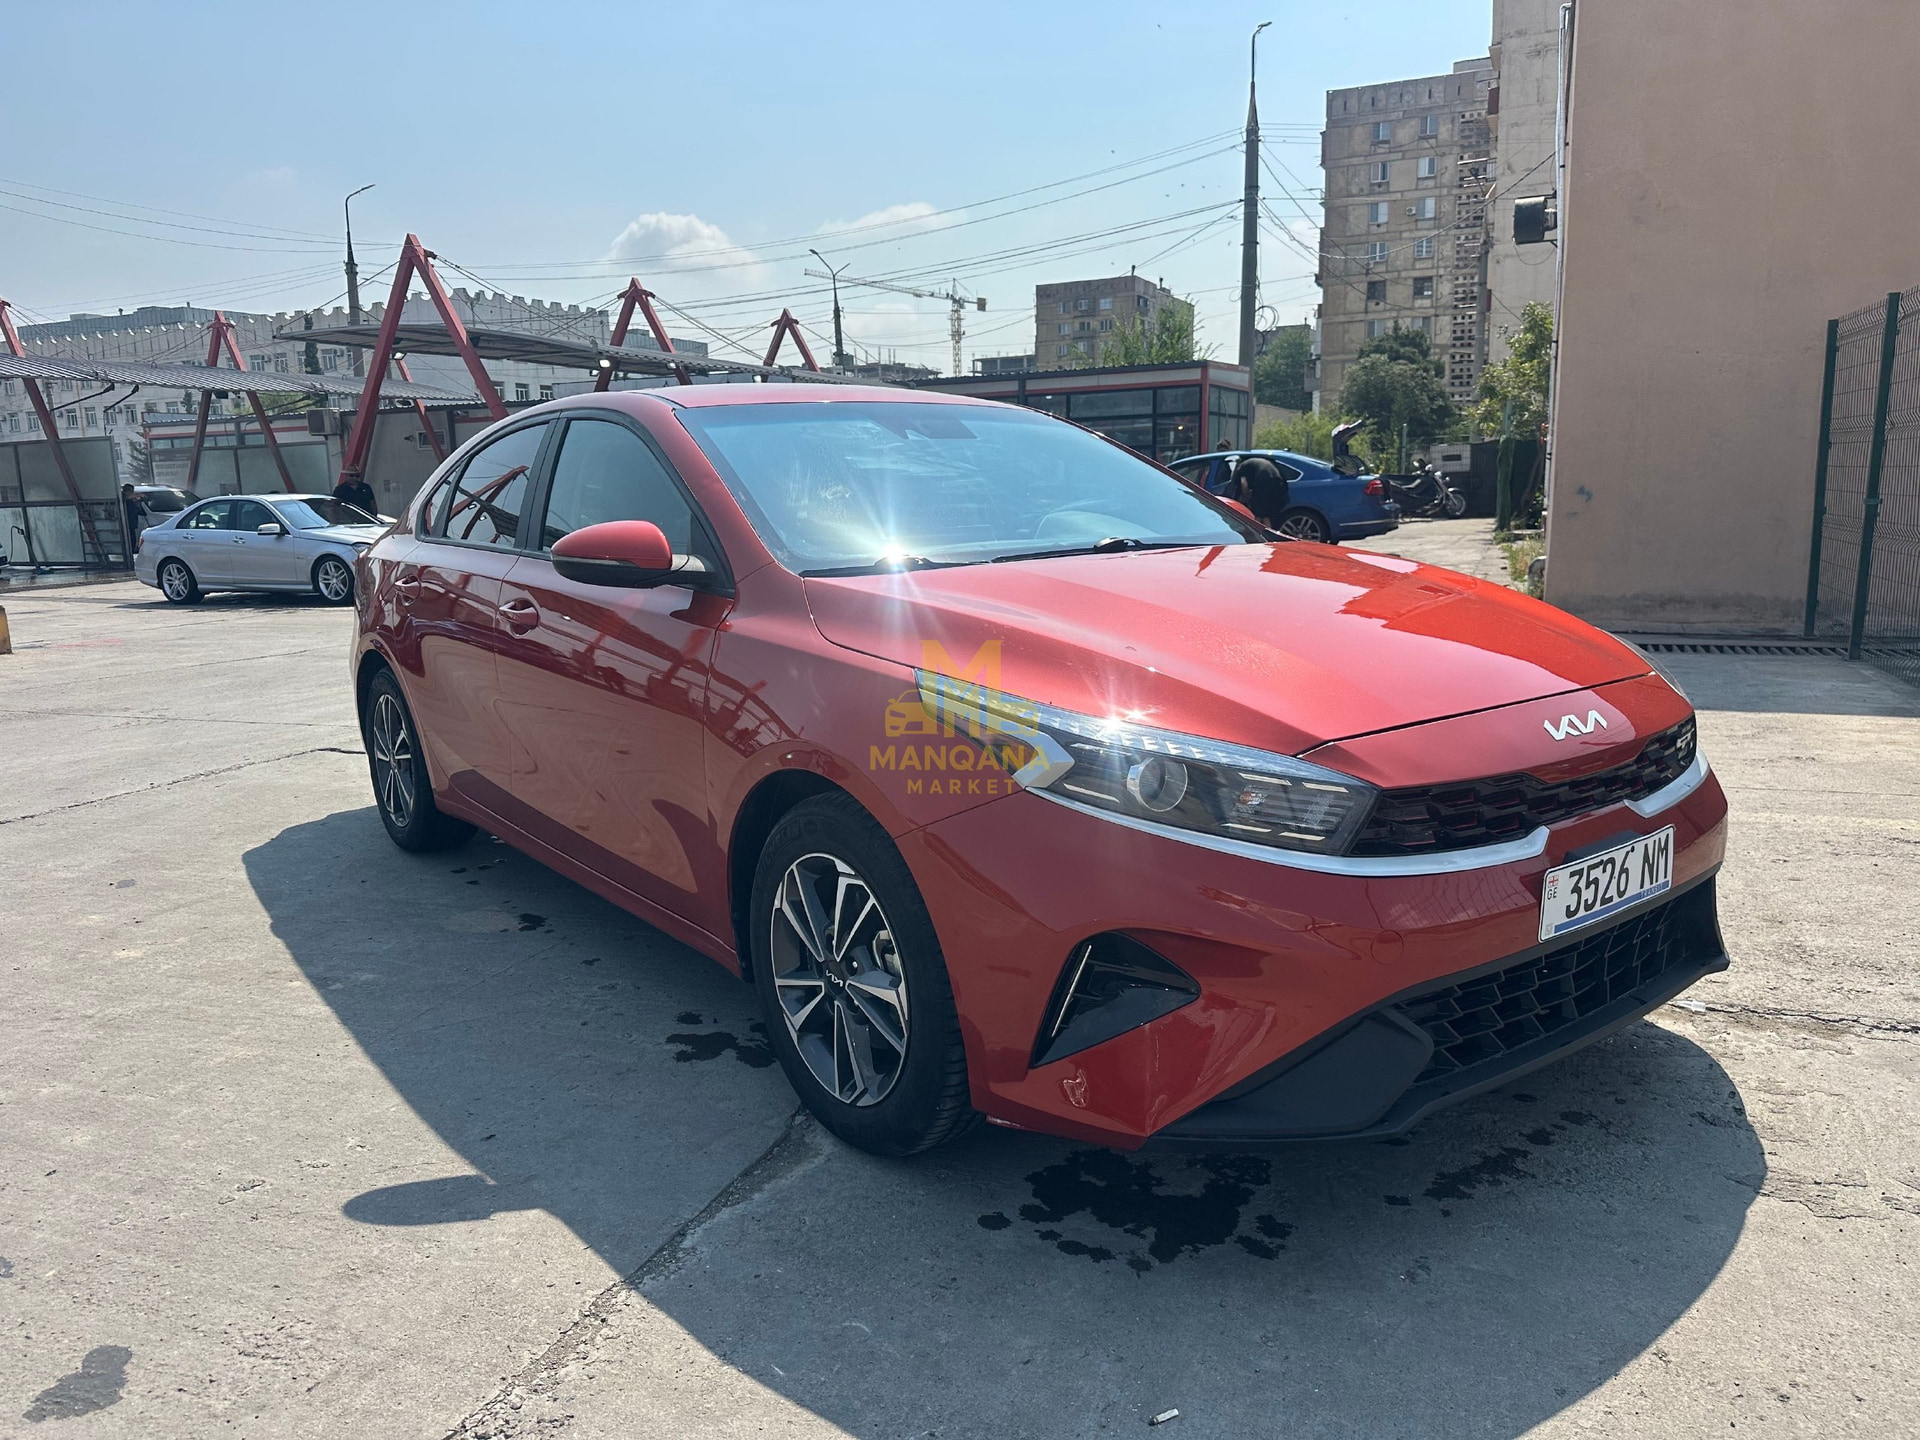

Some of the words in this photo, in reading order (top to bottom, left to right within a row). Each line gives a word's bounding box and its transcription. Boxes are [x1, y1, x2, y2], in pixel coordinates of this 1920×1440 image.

[1544, 709, 1608, 741] KIA
[1565, 848, 1631, 919] 3526
[1640, 833, 1669, 889] NM
[1546, 887, 1558, 901] GE
